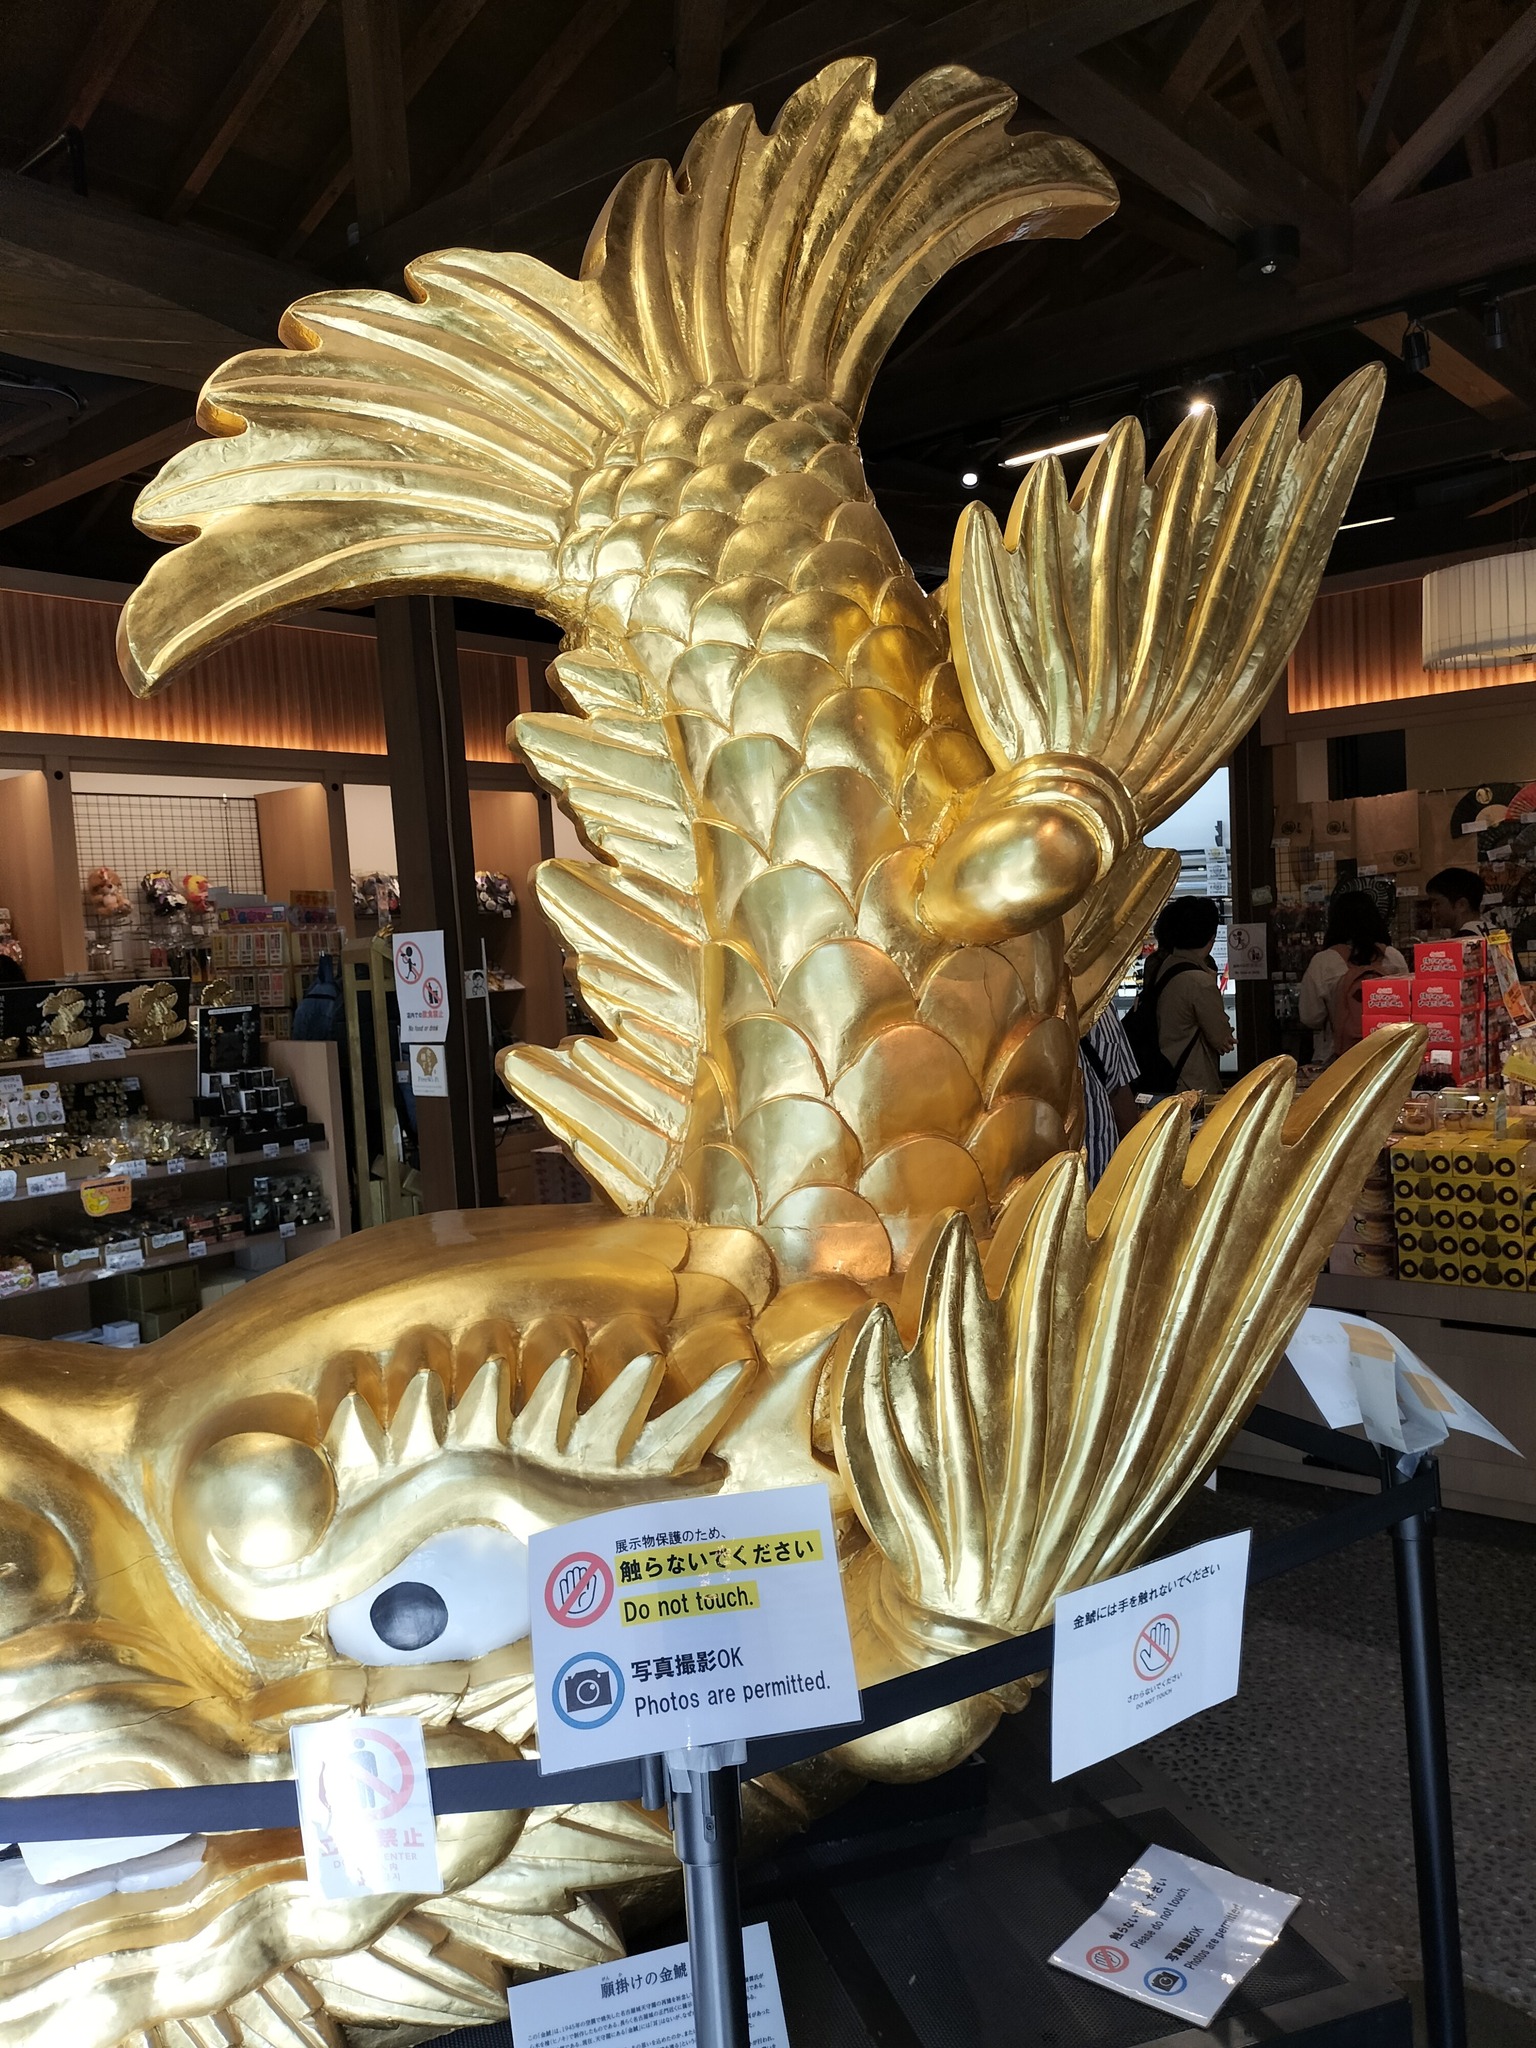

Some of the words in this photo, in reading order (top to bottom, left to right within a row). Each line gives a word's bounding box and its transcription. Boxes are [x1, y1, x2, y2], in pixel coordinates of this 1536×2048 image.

[614, 1526, 727, 1554] 展示物保護のため、
[619, 1539, 815, 1584] 触らないでください
[623, 1600, 650, 1623] Do
[658, 1594, 690, 1617] not
[695, 1585, 755, 1612] touch.
[630, 1646, 745, 1683] 写真撮影OK
[634, 1688, 700, 1718] Photos
[707, 1684, 736, 1706] are
[742, 1670, 831, 1703] permitted.
[1126, 1672, 1184, 1704] さわらないでください
[1135, 1702, 1145, 1711] DO
[1145, 1696, 1156, 1707] NOT
[1156, 1687, 1174, 1701] TOUCH
[1130, 1929, 1156, 1950] Please
[1151, 1920, 1165, 1931] do
[1160, 1907, 1175, 1922] not
[1168, 1887, 1191, 1908] touch.
[1183, 1949, 1211, 1971] Photos
[1205, 1938, 1220, 1951] are
